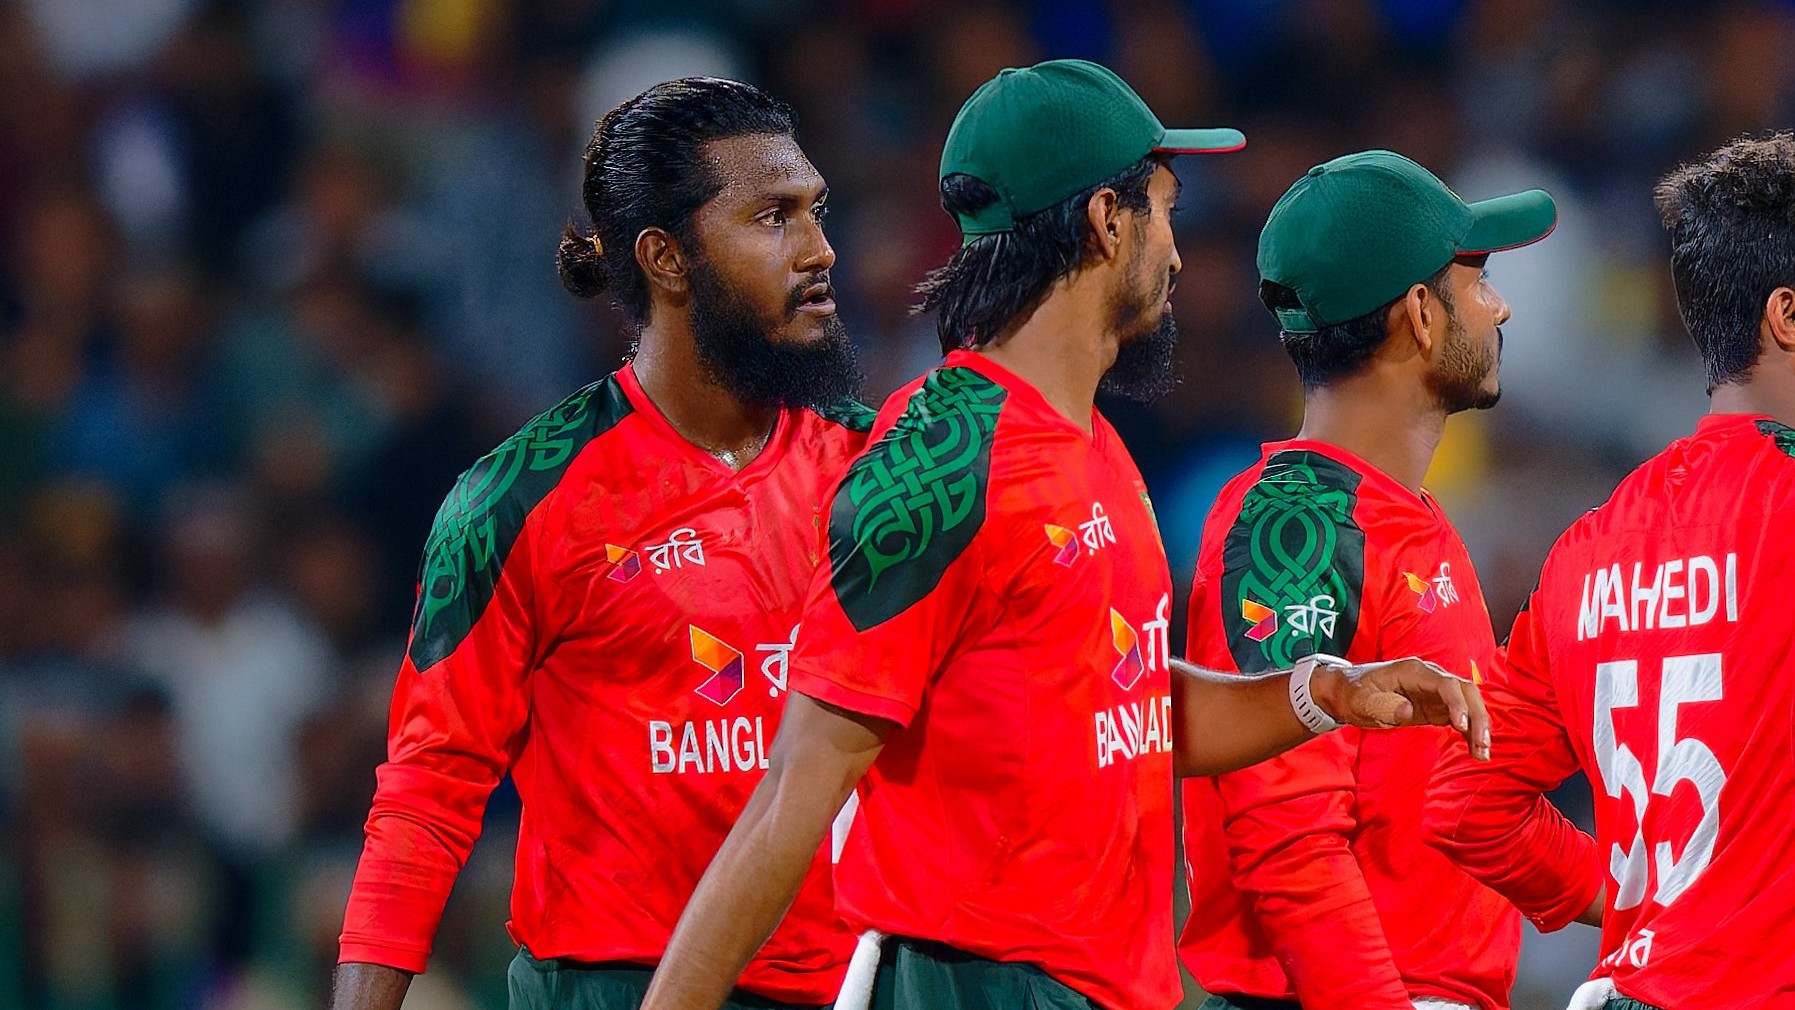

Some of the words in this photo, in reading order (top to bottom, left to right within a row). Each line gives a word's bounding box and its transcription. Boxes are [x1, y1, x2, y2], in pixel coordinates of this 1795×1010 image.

[645, 527, 706, 575] রবি
[1079, 501, 1116, 556] রবি
[1433, 562, 1459, 608] রবি
[1283, 594, 1339, 639] রবি
[649, 716, 770, 775] BANGL
[1593, 652, 1727, 911] 55
